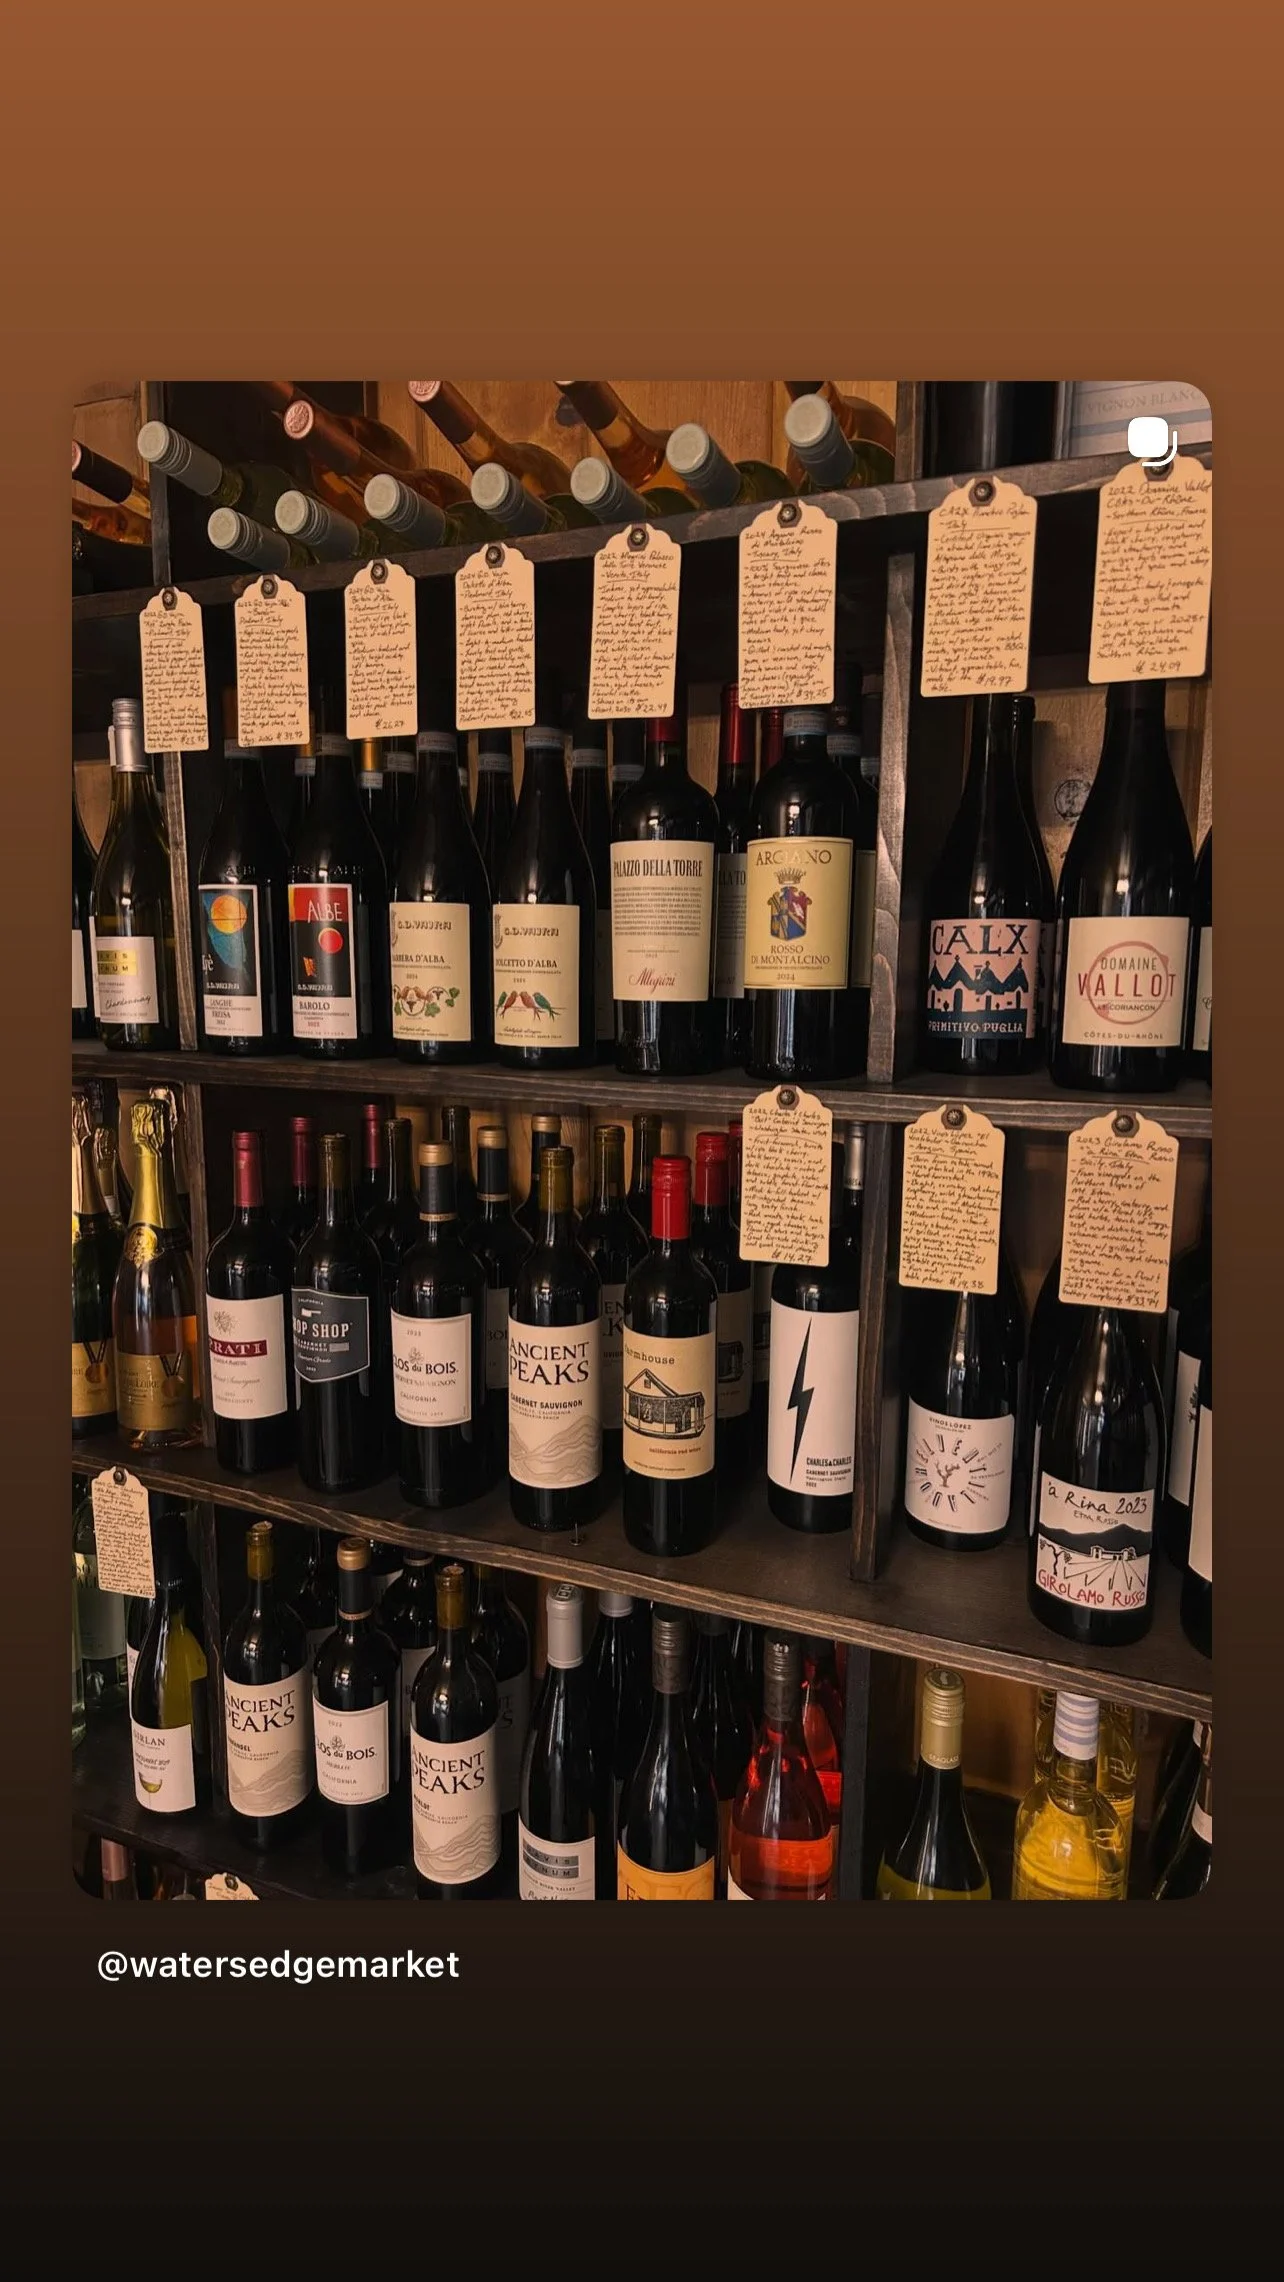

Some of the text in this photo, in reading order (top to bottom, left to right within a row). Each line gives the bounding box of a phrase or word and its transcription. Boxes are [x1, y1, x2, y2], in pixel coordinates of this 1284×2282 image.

[613, 858, 703, 878] PALAZZO DELLA TORRE
[307, 899, 343, 923] ALBE
[932, 923, 1029, 957] CALX
[770, 943, 804, 955] ROSSO
[751, 954, 831, 965] DI MONTALCINO
[1100, 956, 1158, 971] DOMAINE
[1077, 972, 1176, 998] VALLOT
[299, 1001, 331, 1011] BAROLO
[928, 1020, 1024, 1034] PRIMITIVO PUGLIA
[312, 1323, 350, 1338] SHOP
[510, 1337, 590, 1361] ANCIENT
[411, 1364, 422, 1373] du
[510, 1355, 589, 1386] PEAKS
[400, 1391, 437, 1402] CALIFORNIA
[510, 1392, 584, 1410] CABERNET SAUVIGNON
[1064, 1491, 1110, 1514] Rina
[1115, 1496, 1148, 1515] 2023
[1038, 1568, 1150, 1607] GIROLAMO RUSSO
[333, 1750, 343, 1759] du
